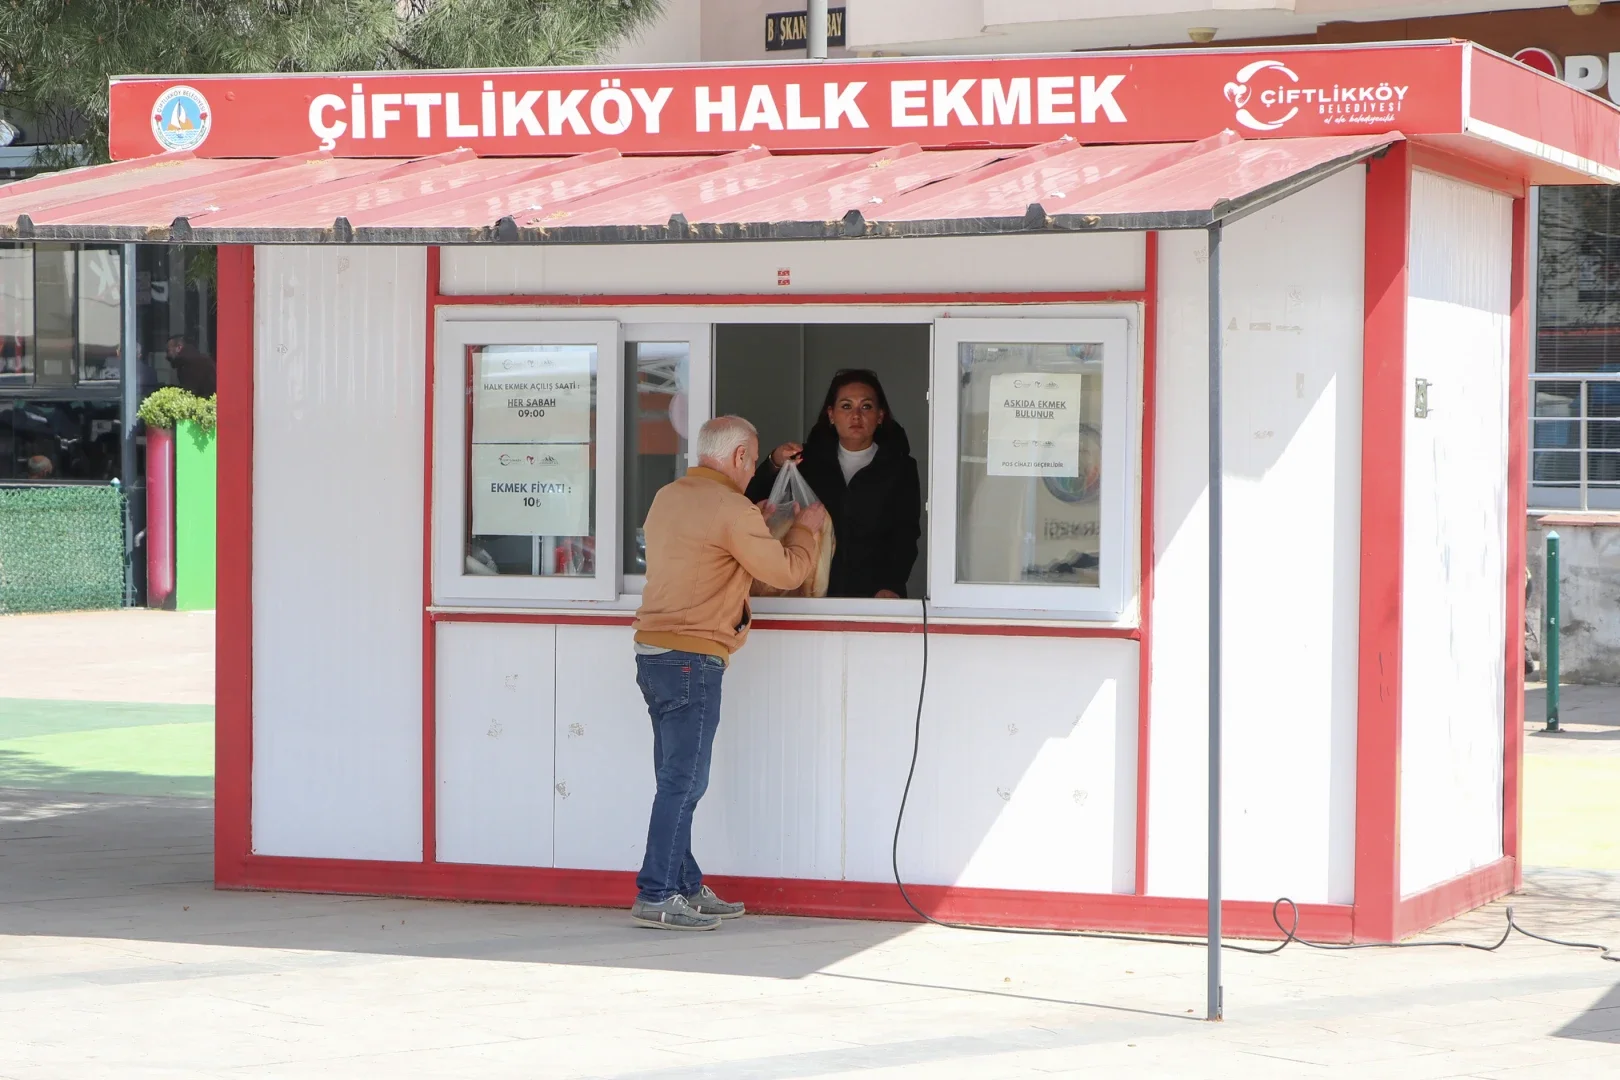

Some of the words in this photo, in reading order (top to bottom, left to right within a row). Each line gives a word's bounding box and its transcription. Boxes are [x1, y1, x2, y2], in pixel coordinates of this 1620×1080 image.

[1260, 82, 1409, 108] ÇİFTLİKKÖY
[308, 78, 674, 151] ÇİFTLİKKÖY
[694, 81, 870, 133] HALK
[890, 74, 1128, 129] EKMEK
[1319, 101, 1401, 115] BELEDİYESİ
[483, 383, 503, 391] HALK
[504, 382, 529, 391] EKMEK
[530, 382, 553, 393] AÇILIŞ
[507, 398, 524, 408] HER
[526, 398, 556, 408] SABAH
[1003, 399, 1036, 409] ASKIDA
[1037, 400, 1067, 410] EKMEK
[518, 409, 545, 418] 09:00
[1015, 409, 1055, 420] BULUNUR
[491, 482, 528, 493] EKMEK
[531, 480, 565, 494] FİYATI
